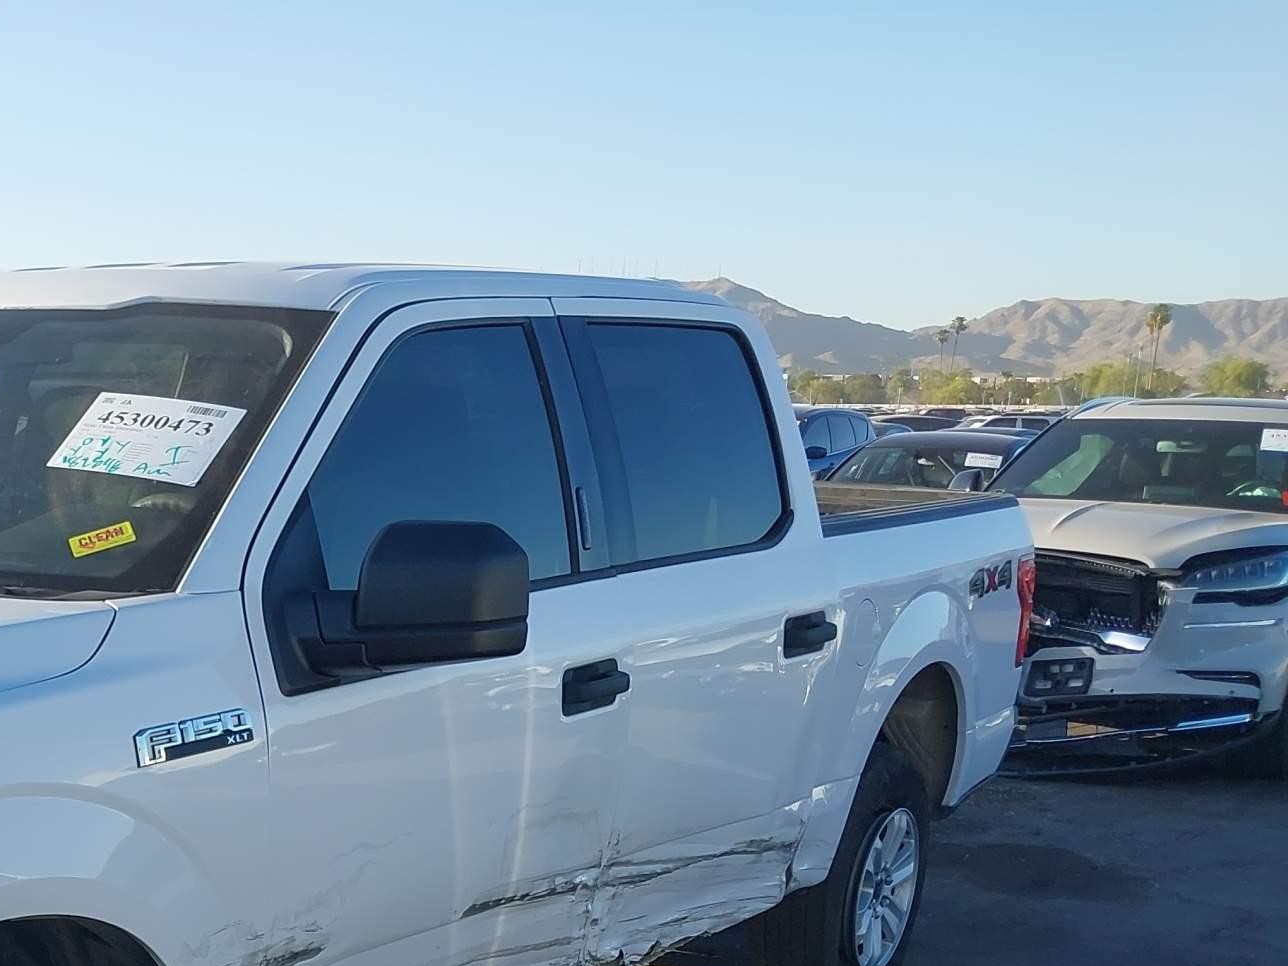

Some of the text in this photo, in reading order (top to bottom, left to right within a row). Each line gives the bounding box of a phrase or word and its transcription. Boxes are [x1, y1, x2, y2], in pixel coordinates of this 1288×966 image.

[97, 410, 214, 437] 45300473
[78, 526, 125, 546] CLEAN
[227, 732, 250, 745] XLT
